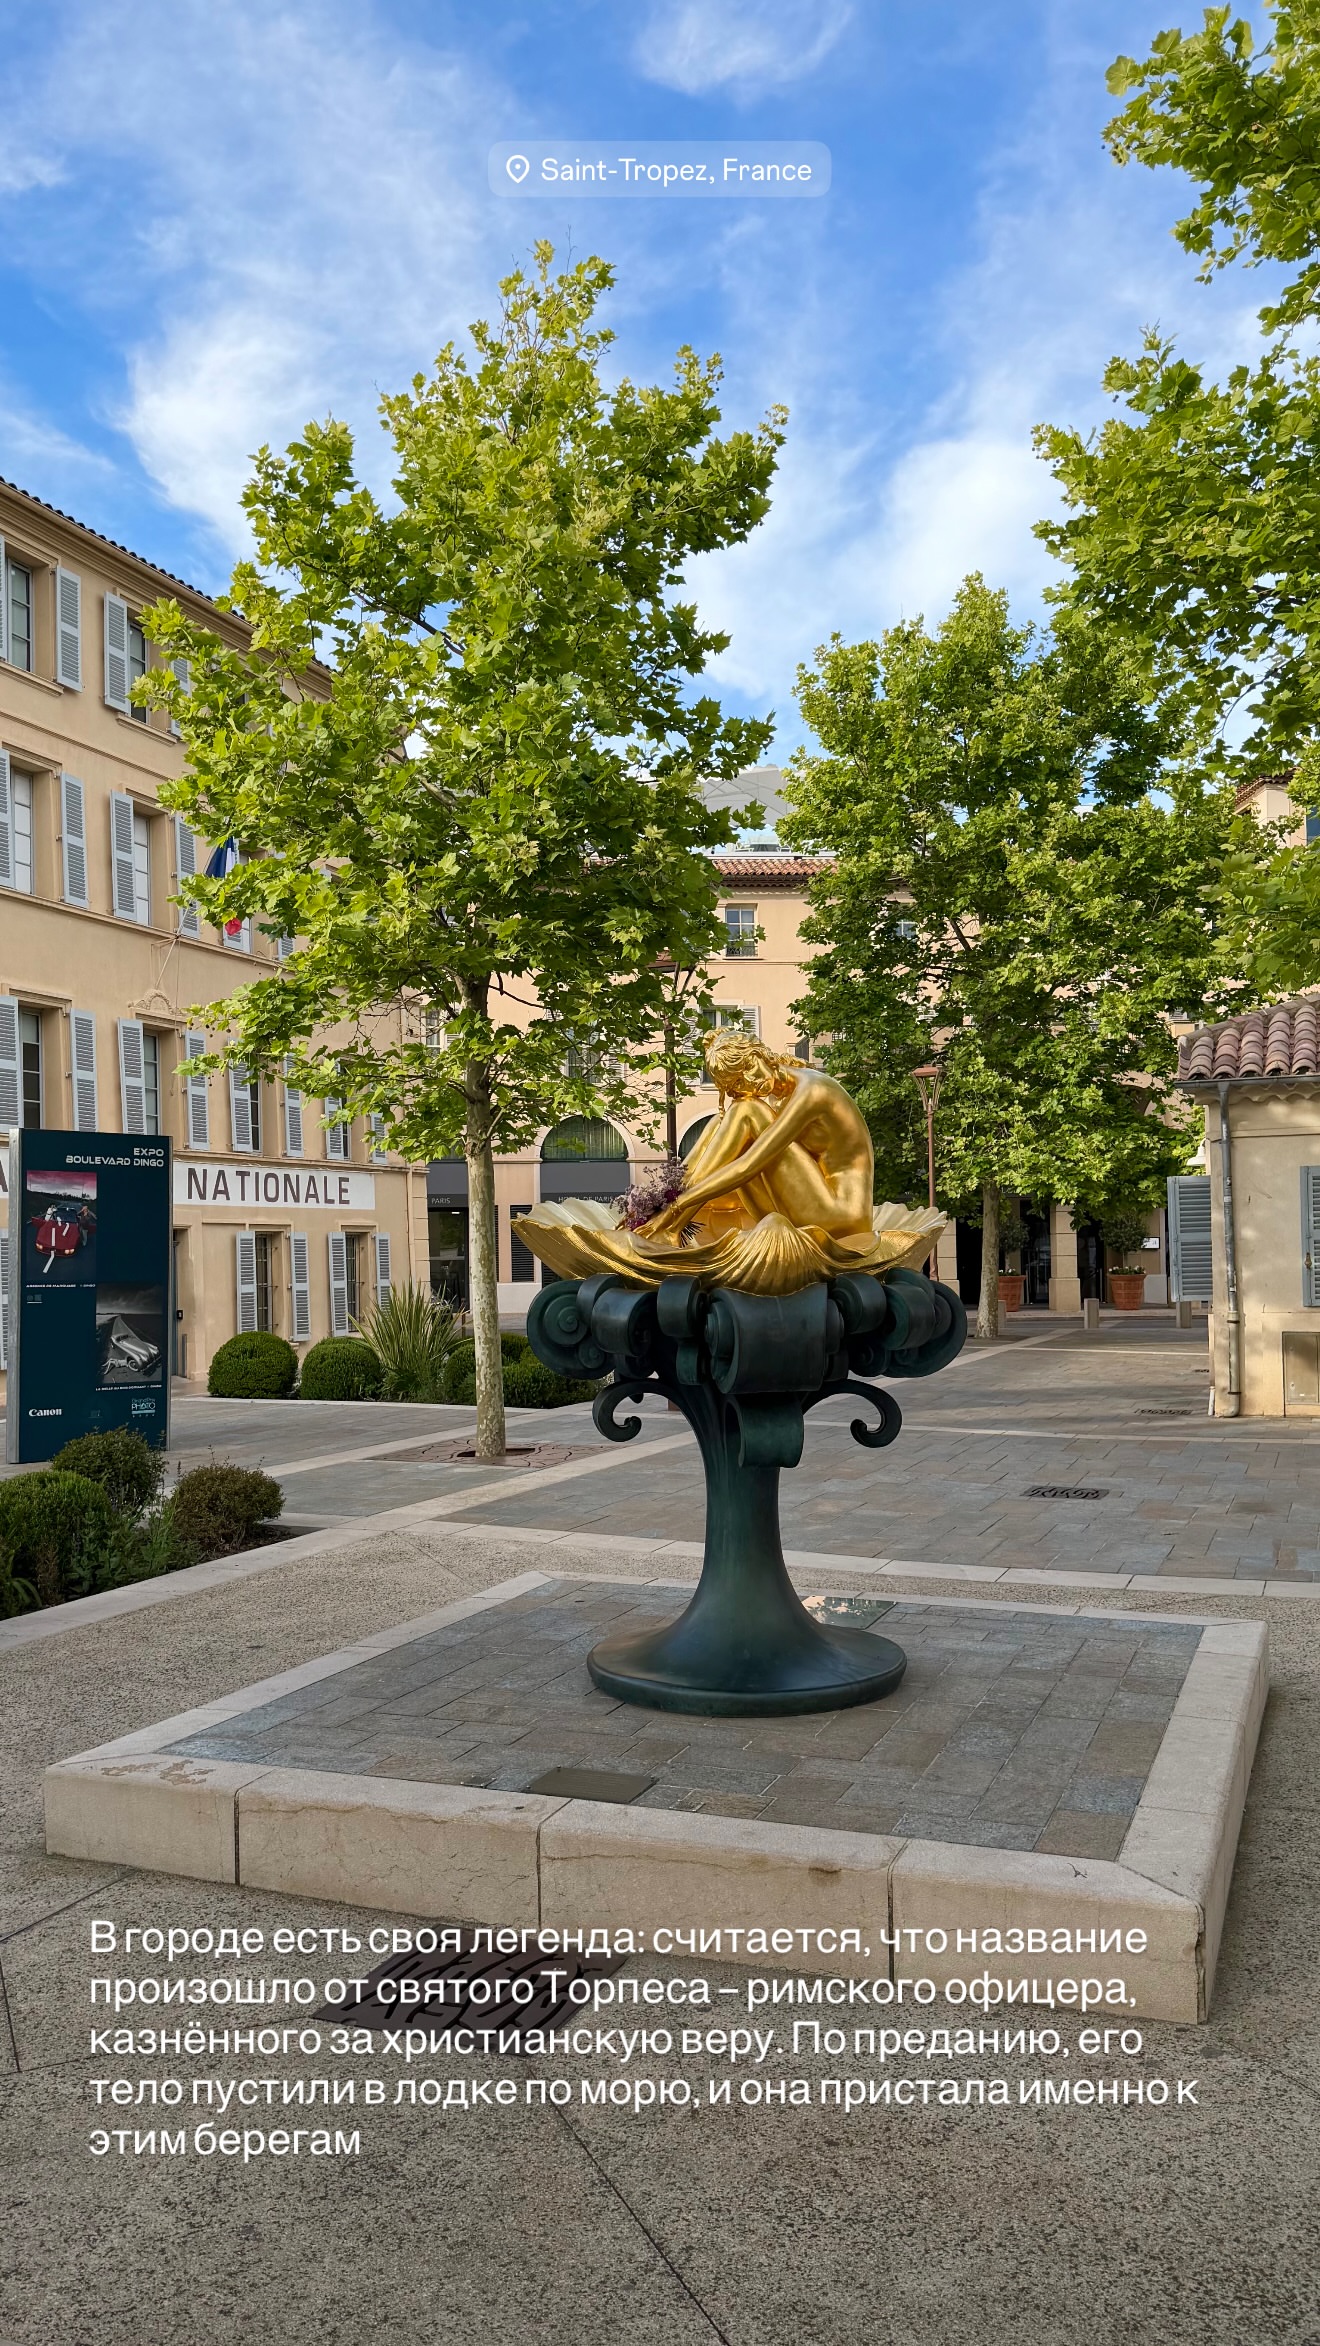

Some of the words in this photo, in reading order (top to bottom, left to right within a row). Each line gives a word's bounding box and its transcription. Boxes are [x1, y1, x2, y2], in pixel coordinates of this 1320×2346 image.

[133, 1147, 165, 1157] EXPO
[65, 1154, 131, 1166] BOULEVARD
[133, 1158, 165, 1168] DINGO
[187, 1167, 350, 1205] NATIONALE
[28, 1408, 63, 1417] Canon
